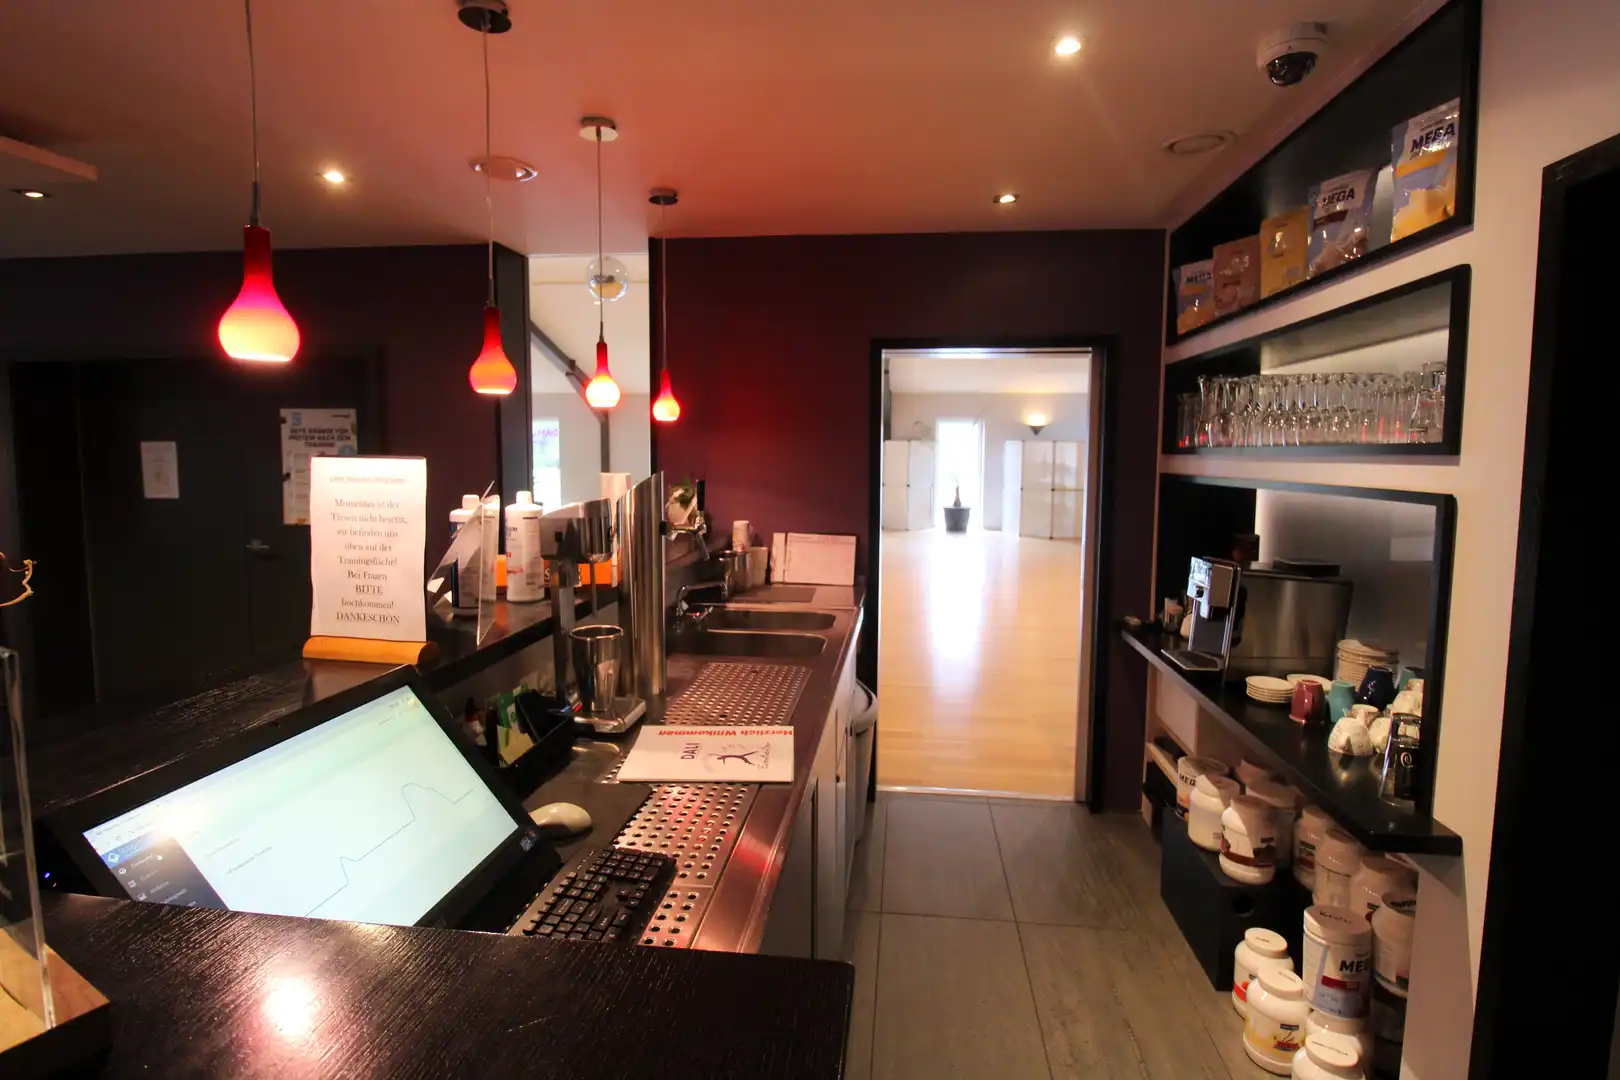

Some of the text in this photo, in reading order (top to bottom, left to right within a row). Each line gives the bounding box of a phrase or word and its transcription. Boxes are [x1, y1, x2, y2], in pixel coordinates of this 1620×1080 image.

[1410, 122, 1456, 154] MEGA
[334, 498, 399, 510] Momentan ist der
[330, 512, 357, 522] Tresen
[358, 513, 377, 523] nicht
[336, 526, 399, 538] wir befinden uns
[344, 542, 392, 552] oben auf der
[347, 570, 387, 581] Bei Fragen
[355, 584, 383, 595] BITTE
[341, 598, 394, 609] hochkommen!
